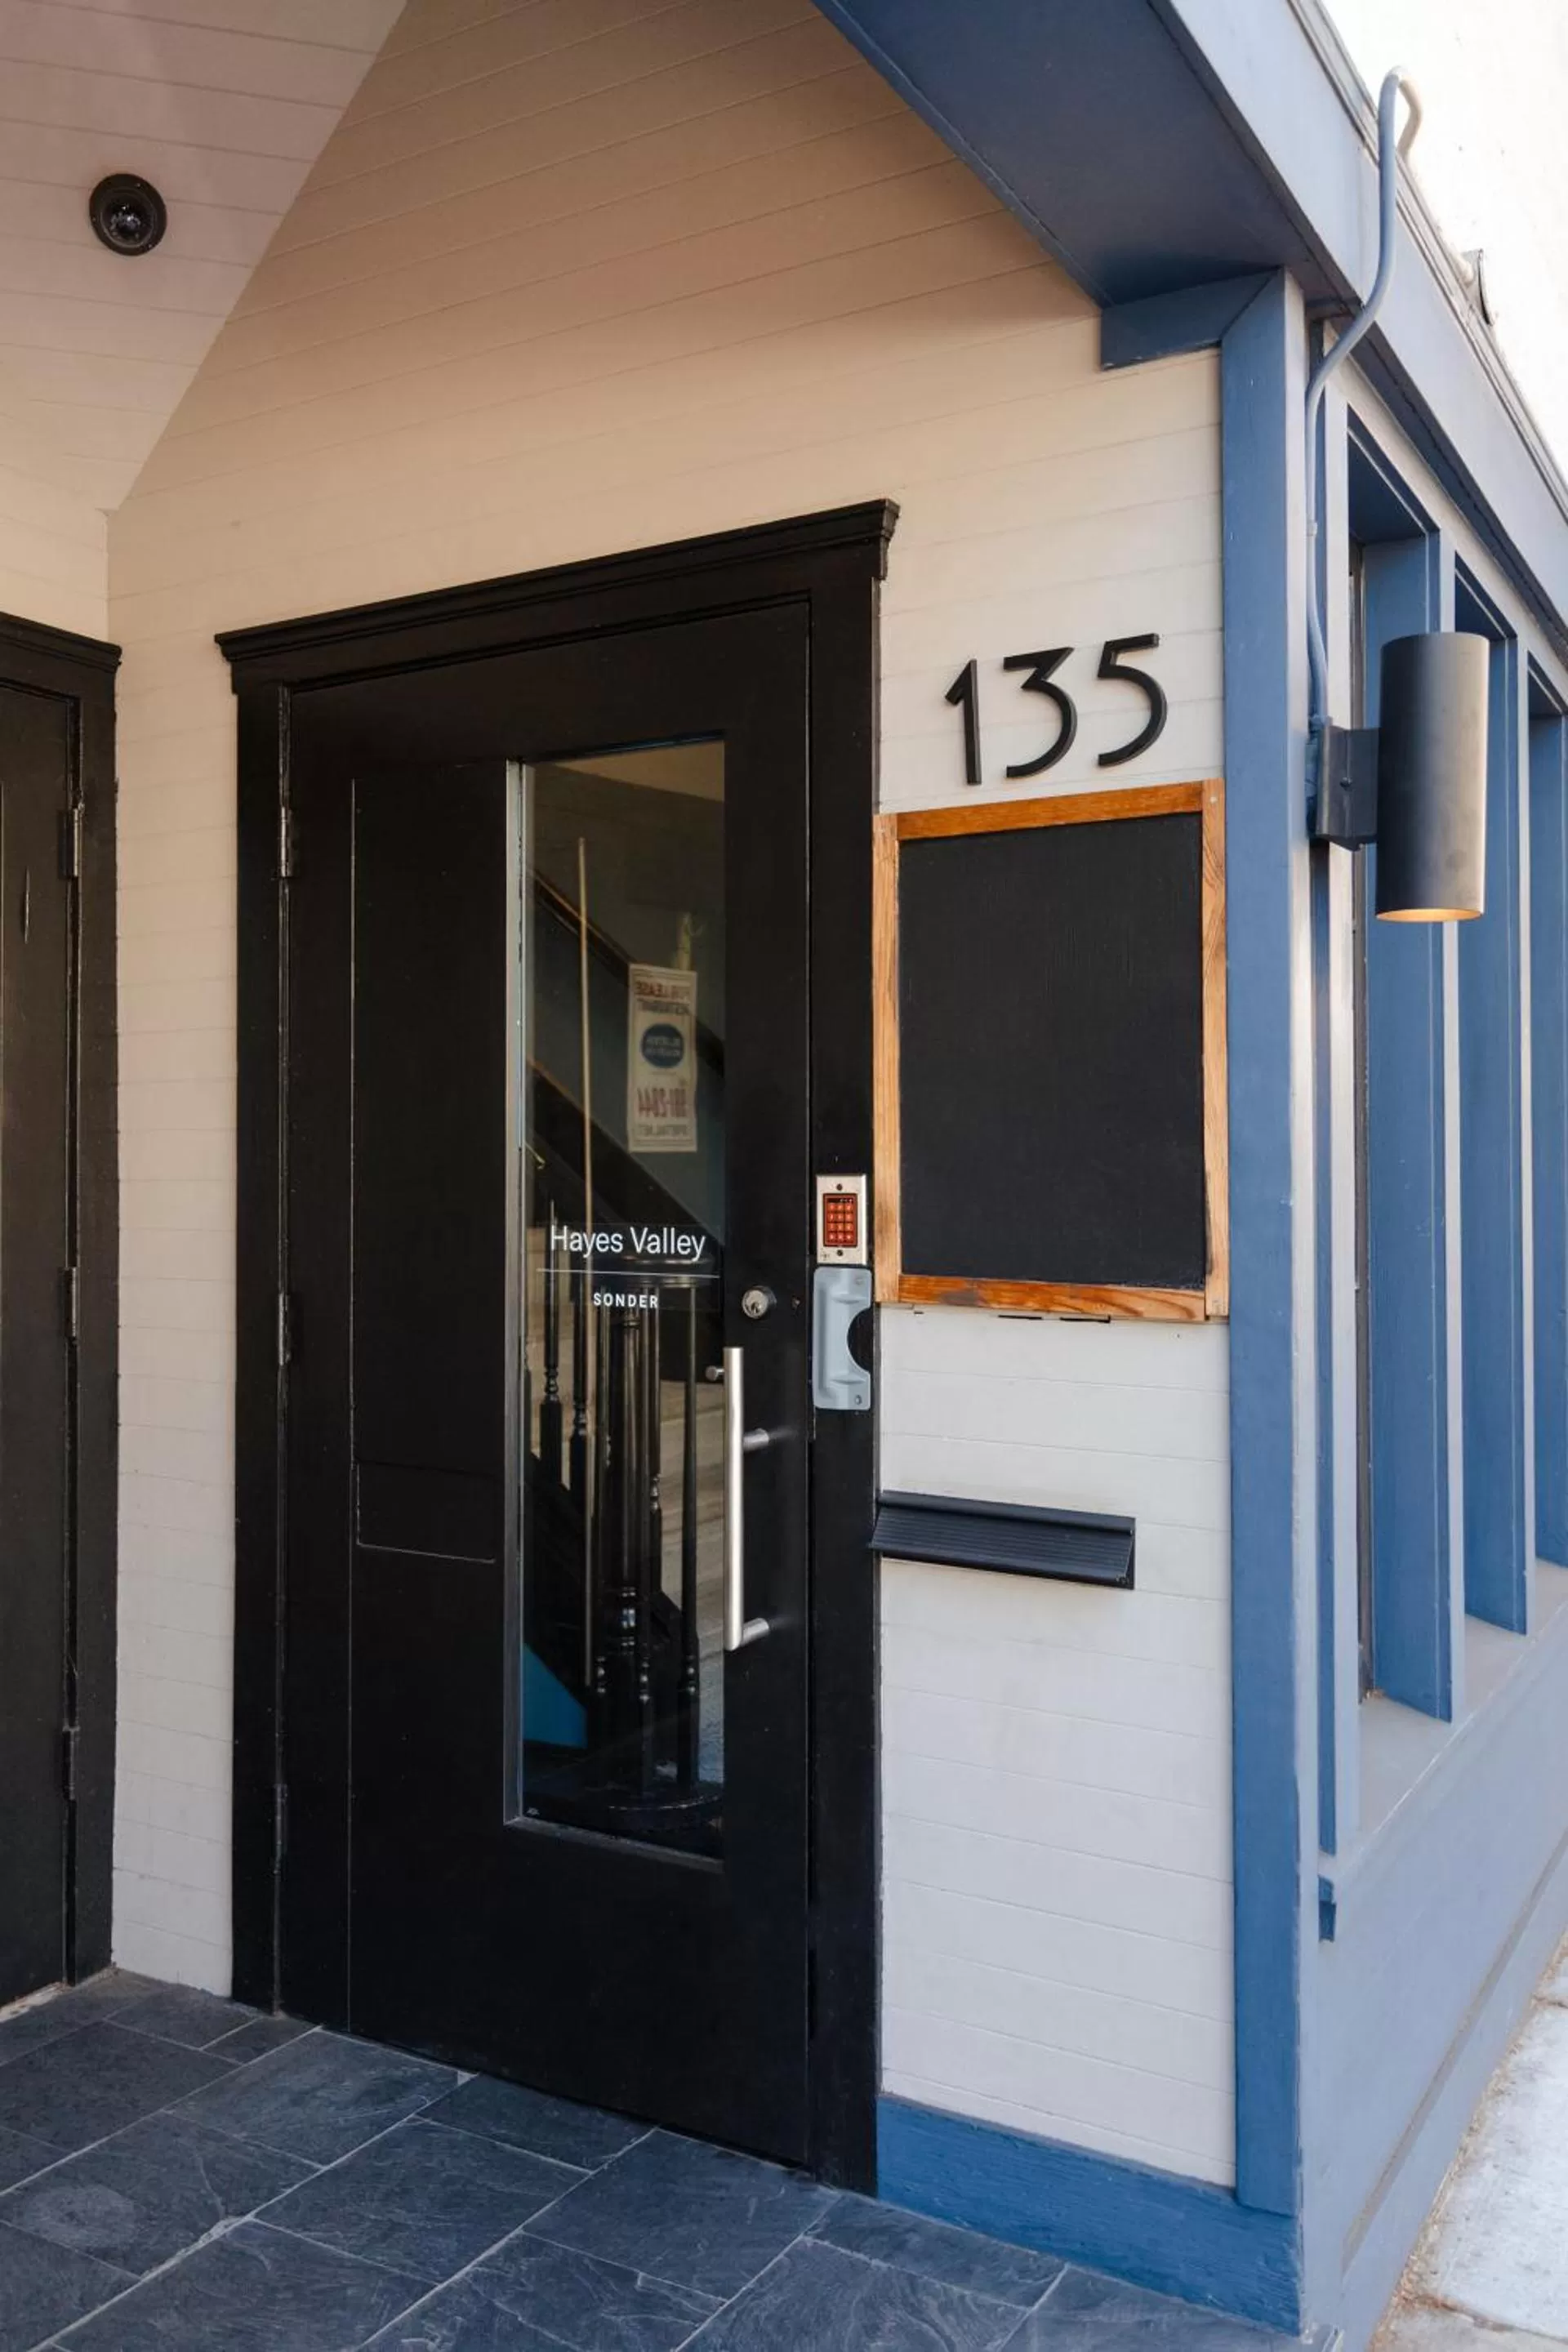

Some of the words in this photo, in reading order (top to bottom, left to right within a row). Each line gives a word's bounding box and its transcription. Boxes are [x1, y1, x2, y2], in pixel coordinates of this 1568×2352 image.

[945, 633, 1167, 785] 135
[550, 1225, 624, 1258] Hayes
[630, 1227, 706, 1263] Valley
[593, 1292, 659, 1308] SONDER
